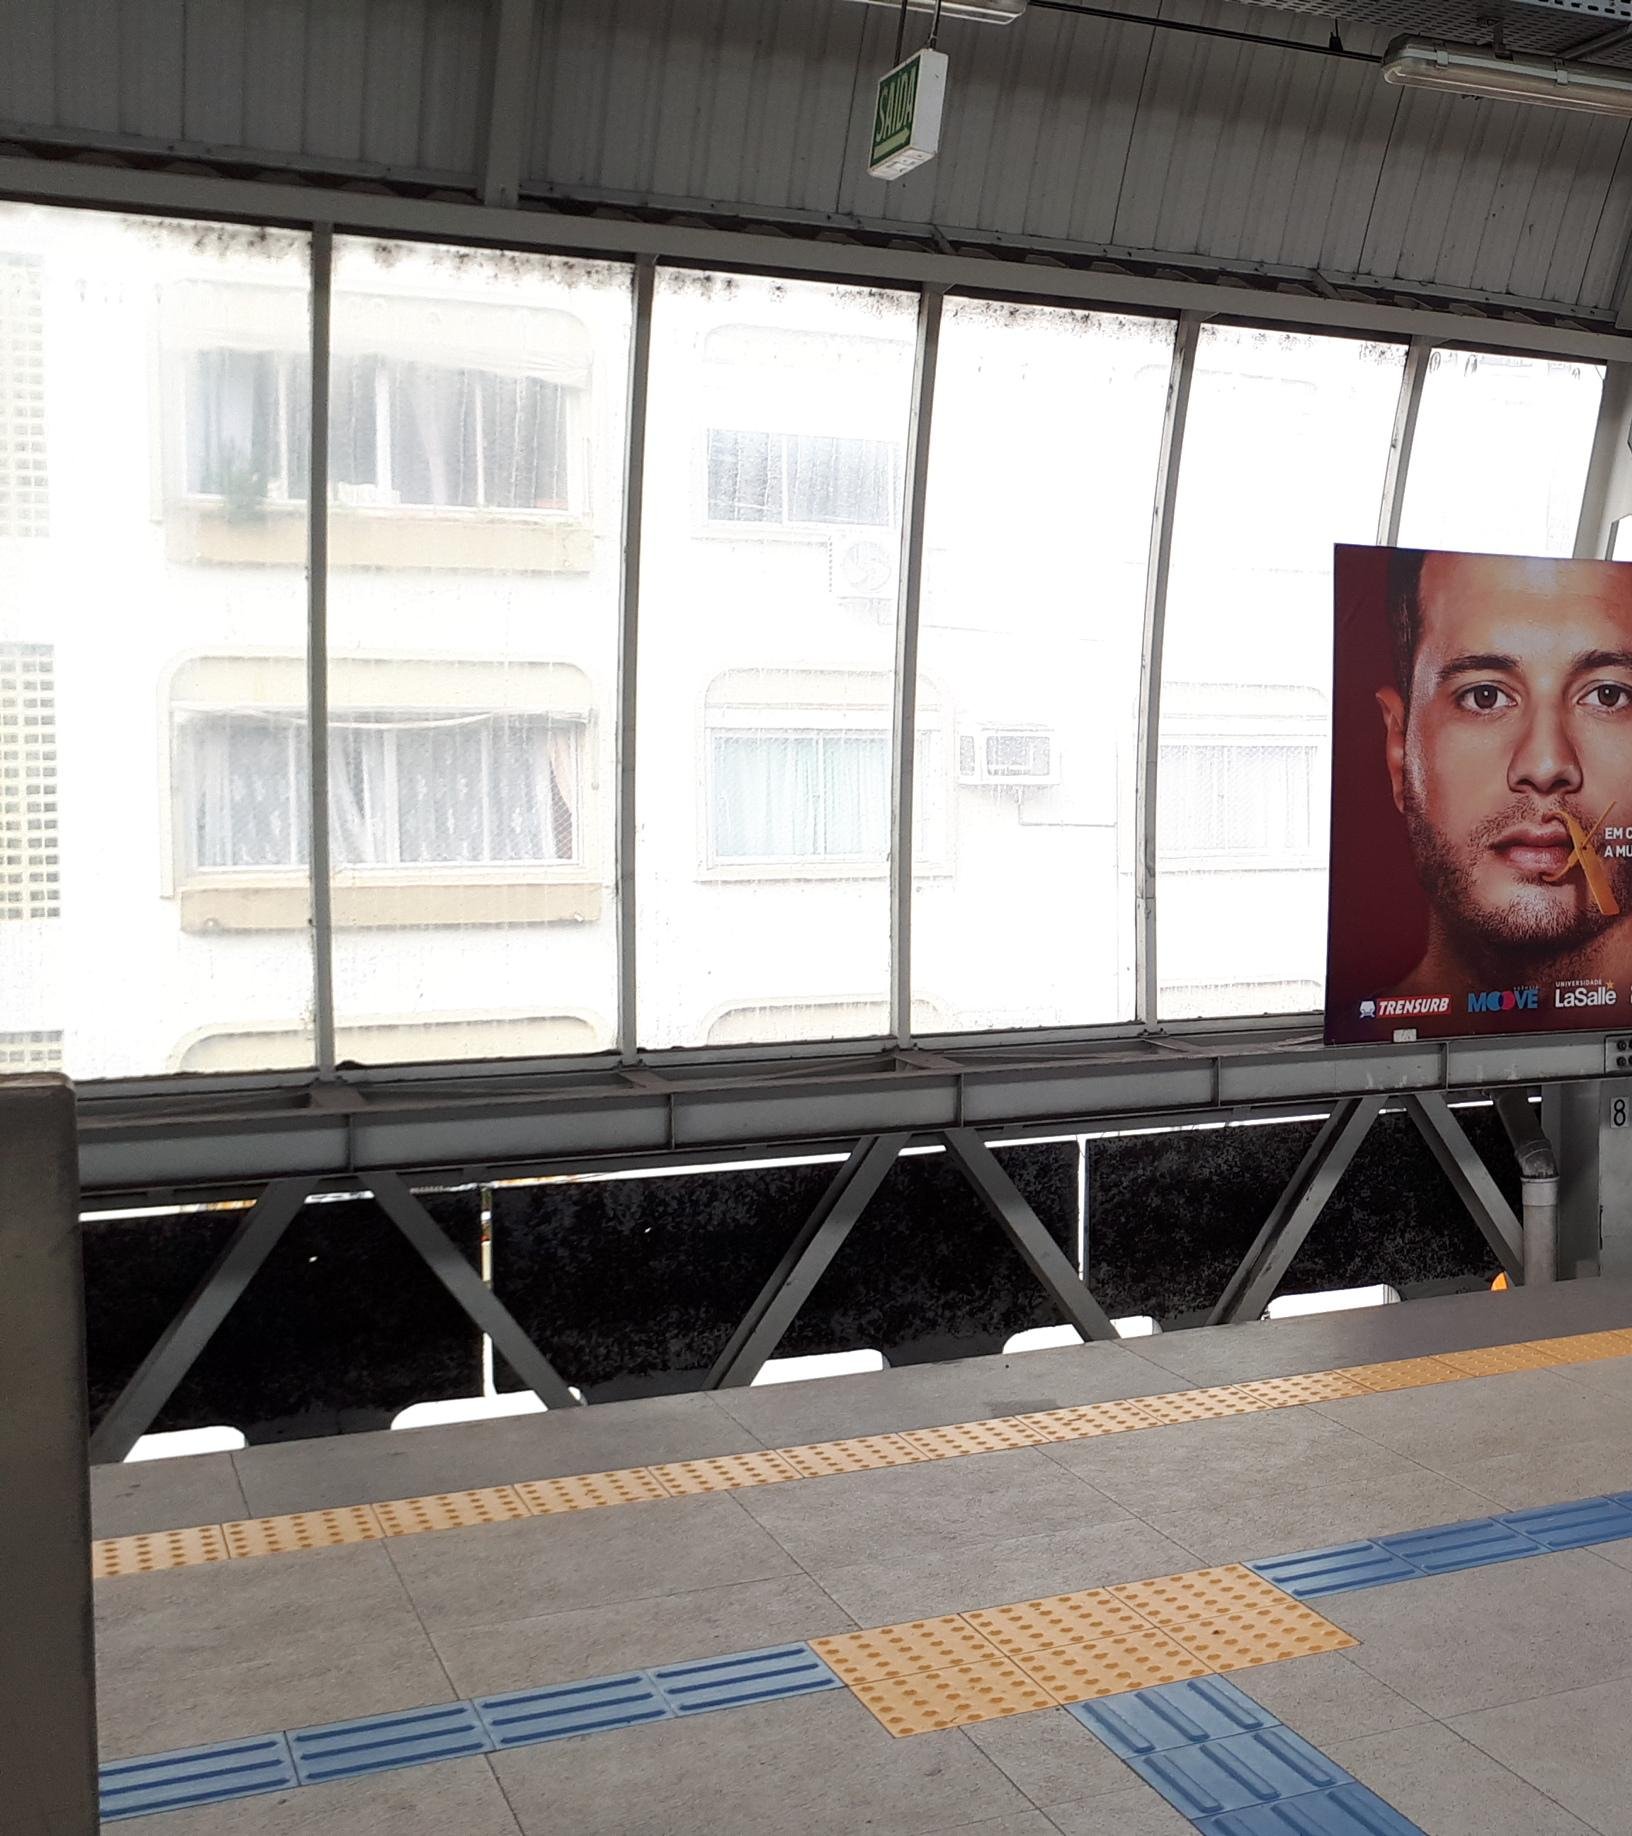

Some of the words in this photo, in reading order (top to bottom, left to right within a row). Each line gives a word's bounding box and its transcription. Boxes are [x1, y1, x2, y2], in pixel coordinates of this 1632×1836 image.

[1604, 827, 1623, 840] EM
[1604, 845, 1613, 857] A
[1555, 978, 1603, 988] UNIVERSIDADE
[1554, 986, 1617, 1008] LaSalle
[1378, 997, 1450, 1016] TRENSURB
[1613, 1098, 1626, 1127] 8
